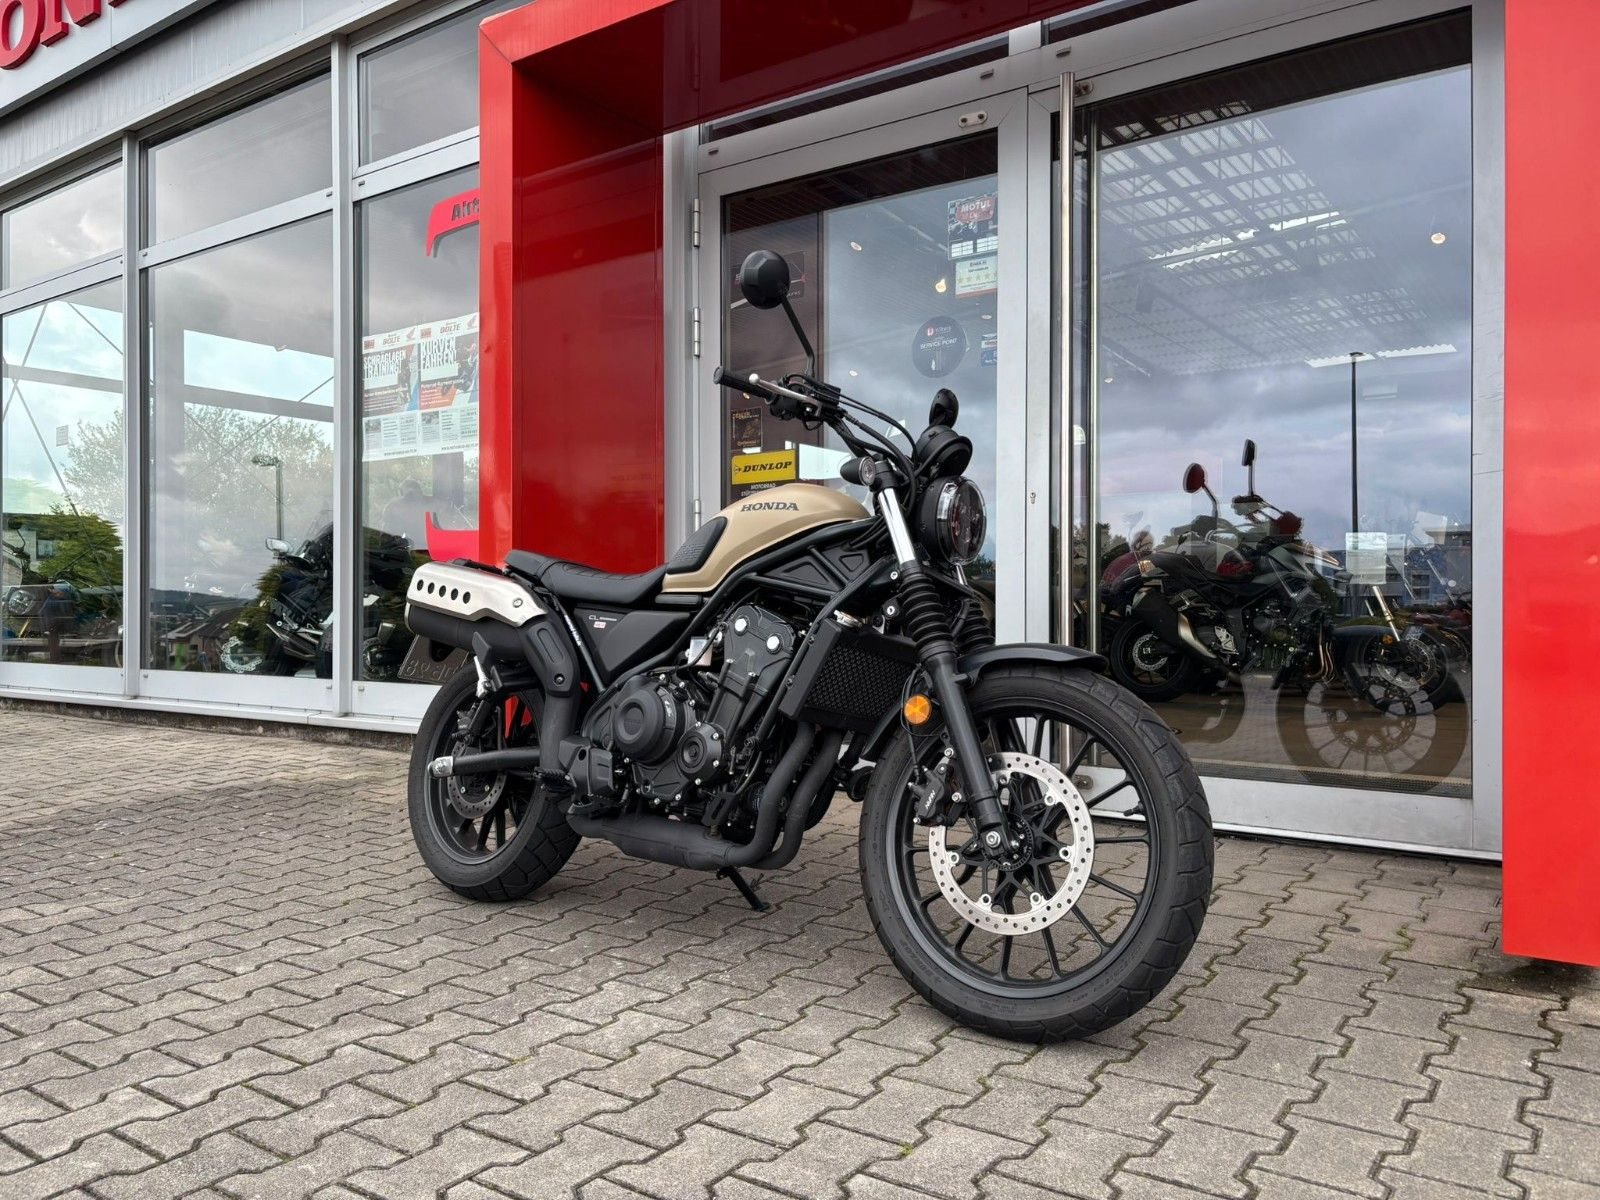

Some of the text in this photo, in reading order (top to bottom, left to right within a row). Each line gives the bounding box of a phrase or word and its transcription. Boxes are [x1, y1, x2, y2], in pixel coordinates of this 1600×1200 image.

[960, 199, 992, 214] MOTUL
[420, 337, 456, 356] KURVEN
[941, 337, 958, 346] POINT
[420, 349, 458, 370] FAHREN!
[363, 361, 402, 379] TRAINING!
[743, 461, 792, 473] DUNLOP
[740, 502, 800, 512] HONDA
